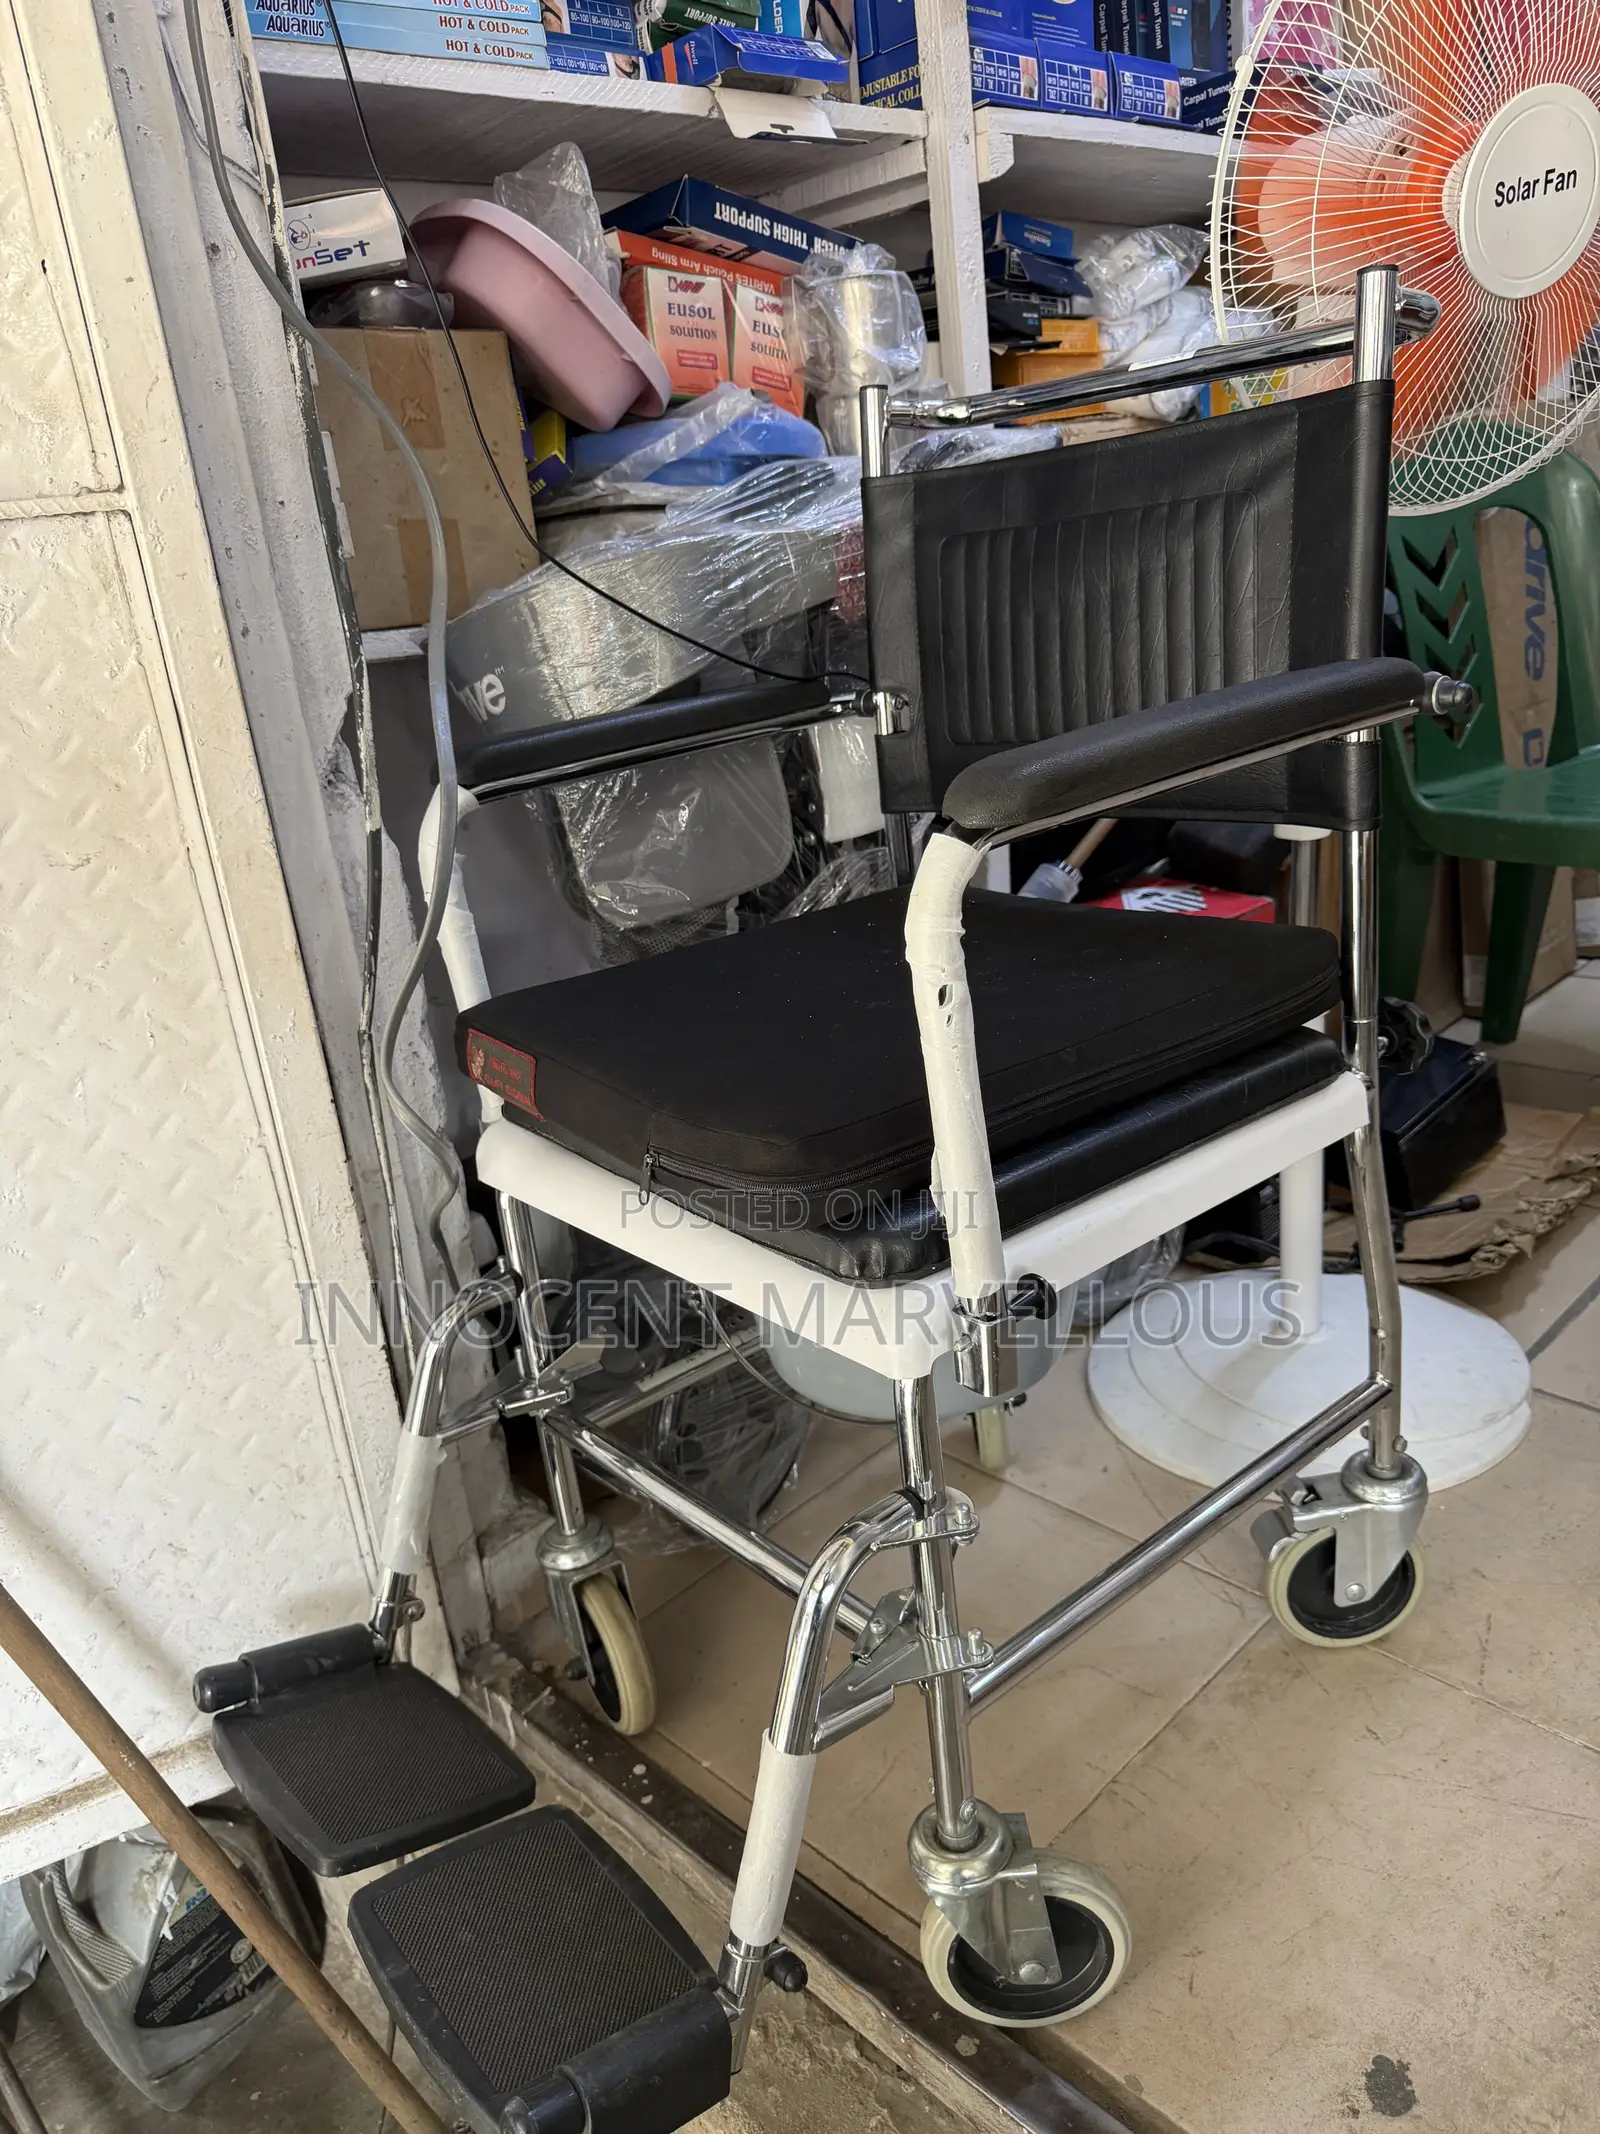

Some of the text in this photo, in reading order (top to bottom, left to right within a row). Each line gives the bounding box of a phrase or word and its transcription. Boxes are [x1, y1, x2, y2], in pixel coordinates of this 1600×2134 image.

[475, 0, 509, 12] COLD
[510, 5, 530, 13] PACK
[597, 5, 602, 13] L
[615, 8, 624, 17] XL
[684, 7, 718, 25] SUPPORT
[439, 16, 530, 36] HOT & COLD PACK
[1098, 4, 1108, 34] Carpal
[1154, 16, 1163, 50] Tunnel
[446, 39, 534, 60] HOT & COLD PACK
[1183, 90, 1207, 106] Carpal
[1494, 168, 1578, 208] Solar Fan
[713, 201, 771, 237] SUPPORT
[773, 221, 808, 250] THIGH
[651, 246, 678, 266] Sling
[680, 256, 701, 273] Arm
[703, 265, 733, 284] Pouch
[667, 302, 716, 320] EUSOL
[670, 324, 717, 340] SOLUTION
